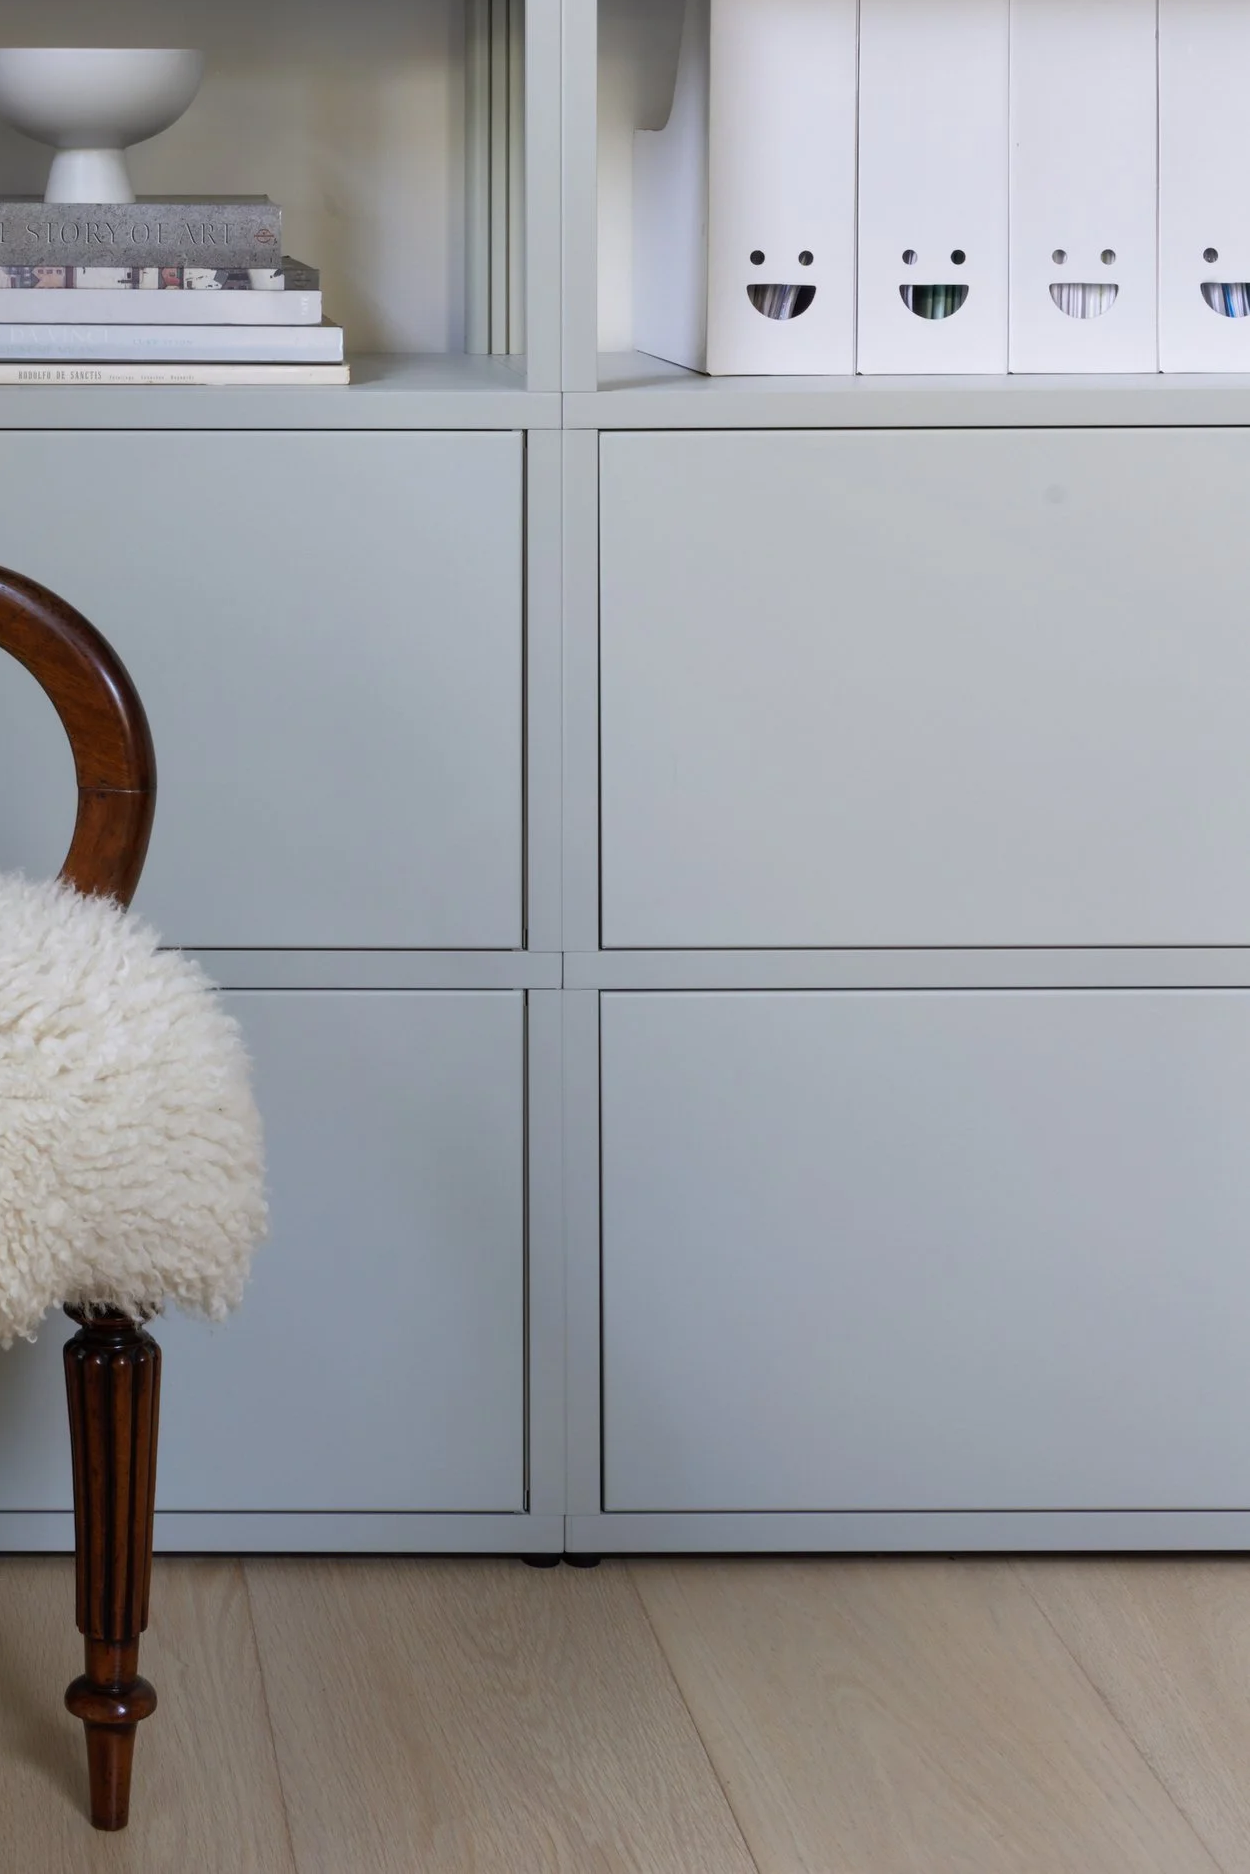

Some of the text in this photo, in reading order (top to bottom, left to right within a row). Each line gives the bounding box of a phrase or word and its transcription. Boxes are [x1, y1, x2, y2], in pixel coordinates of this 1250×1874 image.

[24, 222, 125, 246] STORY
[131, 222, 170, 245] OF
[177, 222, 234, 245] ART
[18, 370, 51, 380] RODOLFO
[56, 371, 66, 380] DE
[70, 371, 102, 380] SANCTIS
